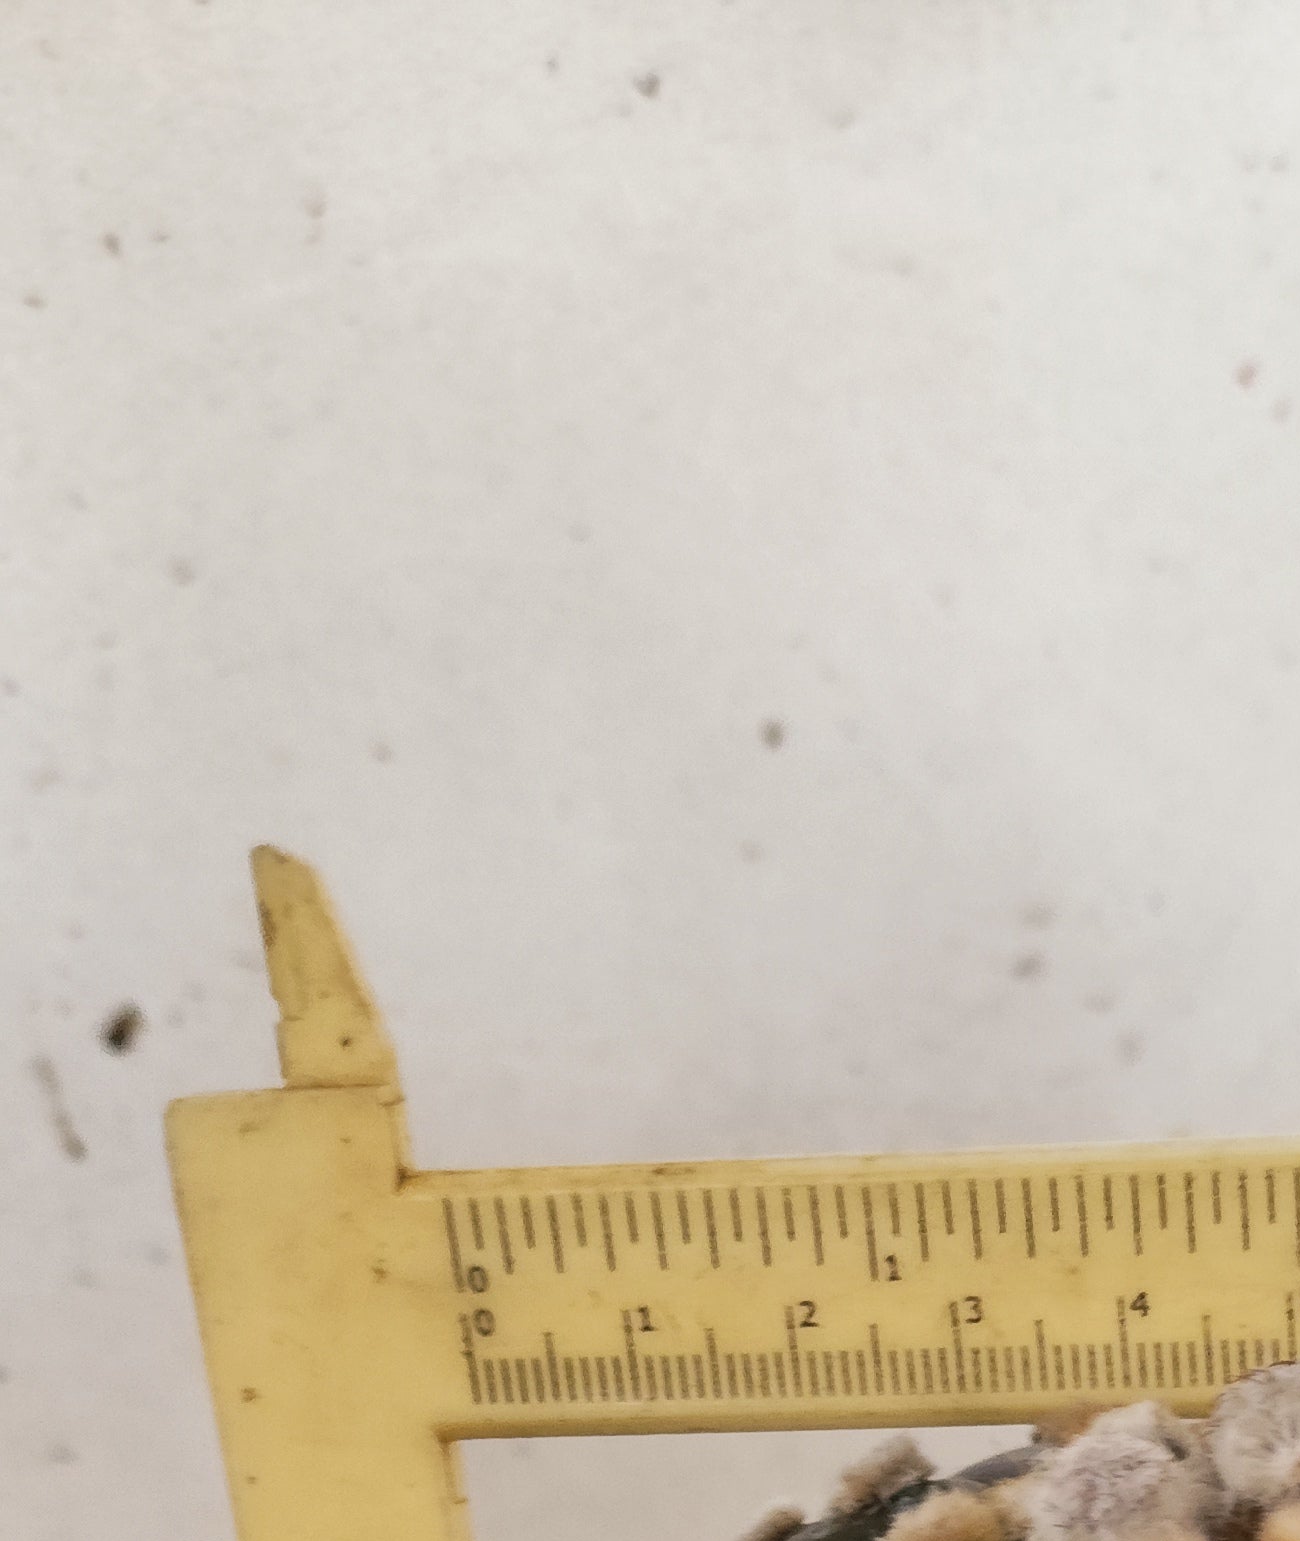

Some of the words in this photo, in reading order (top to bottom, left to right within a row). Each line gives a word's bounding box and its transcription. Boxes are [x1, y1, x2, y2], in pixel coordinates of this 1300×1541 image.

[467, 1265, 490, 1294] 0
[883, 1254, 902, 1282] 1
[473, 1309, 496, 1337] 0
[637, 1305, 659, 1333] 1
[798, 1299, 819, 1328] 2
[963, 1295, 984, 1325] 3
[1130, 1290, 1152, 1318] 4
